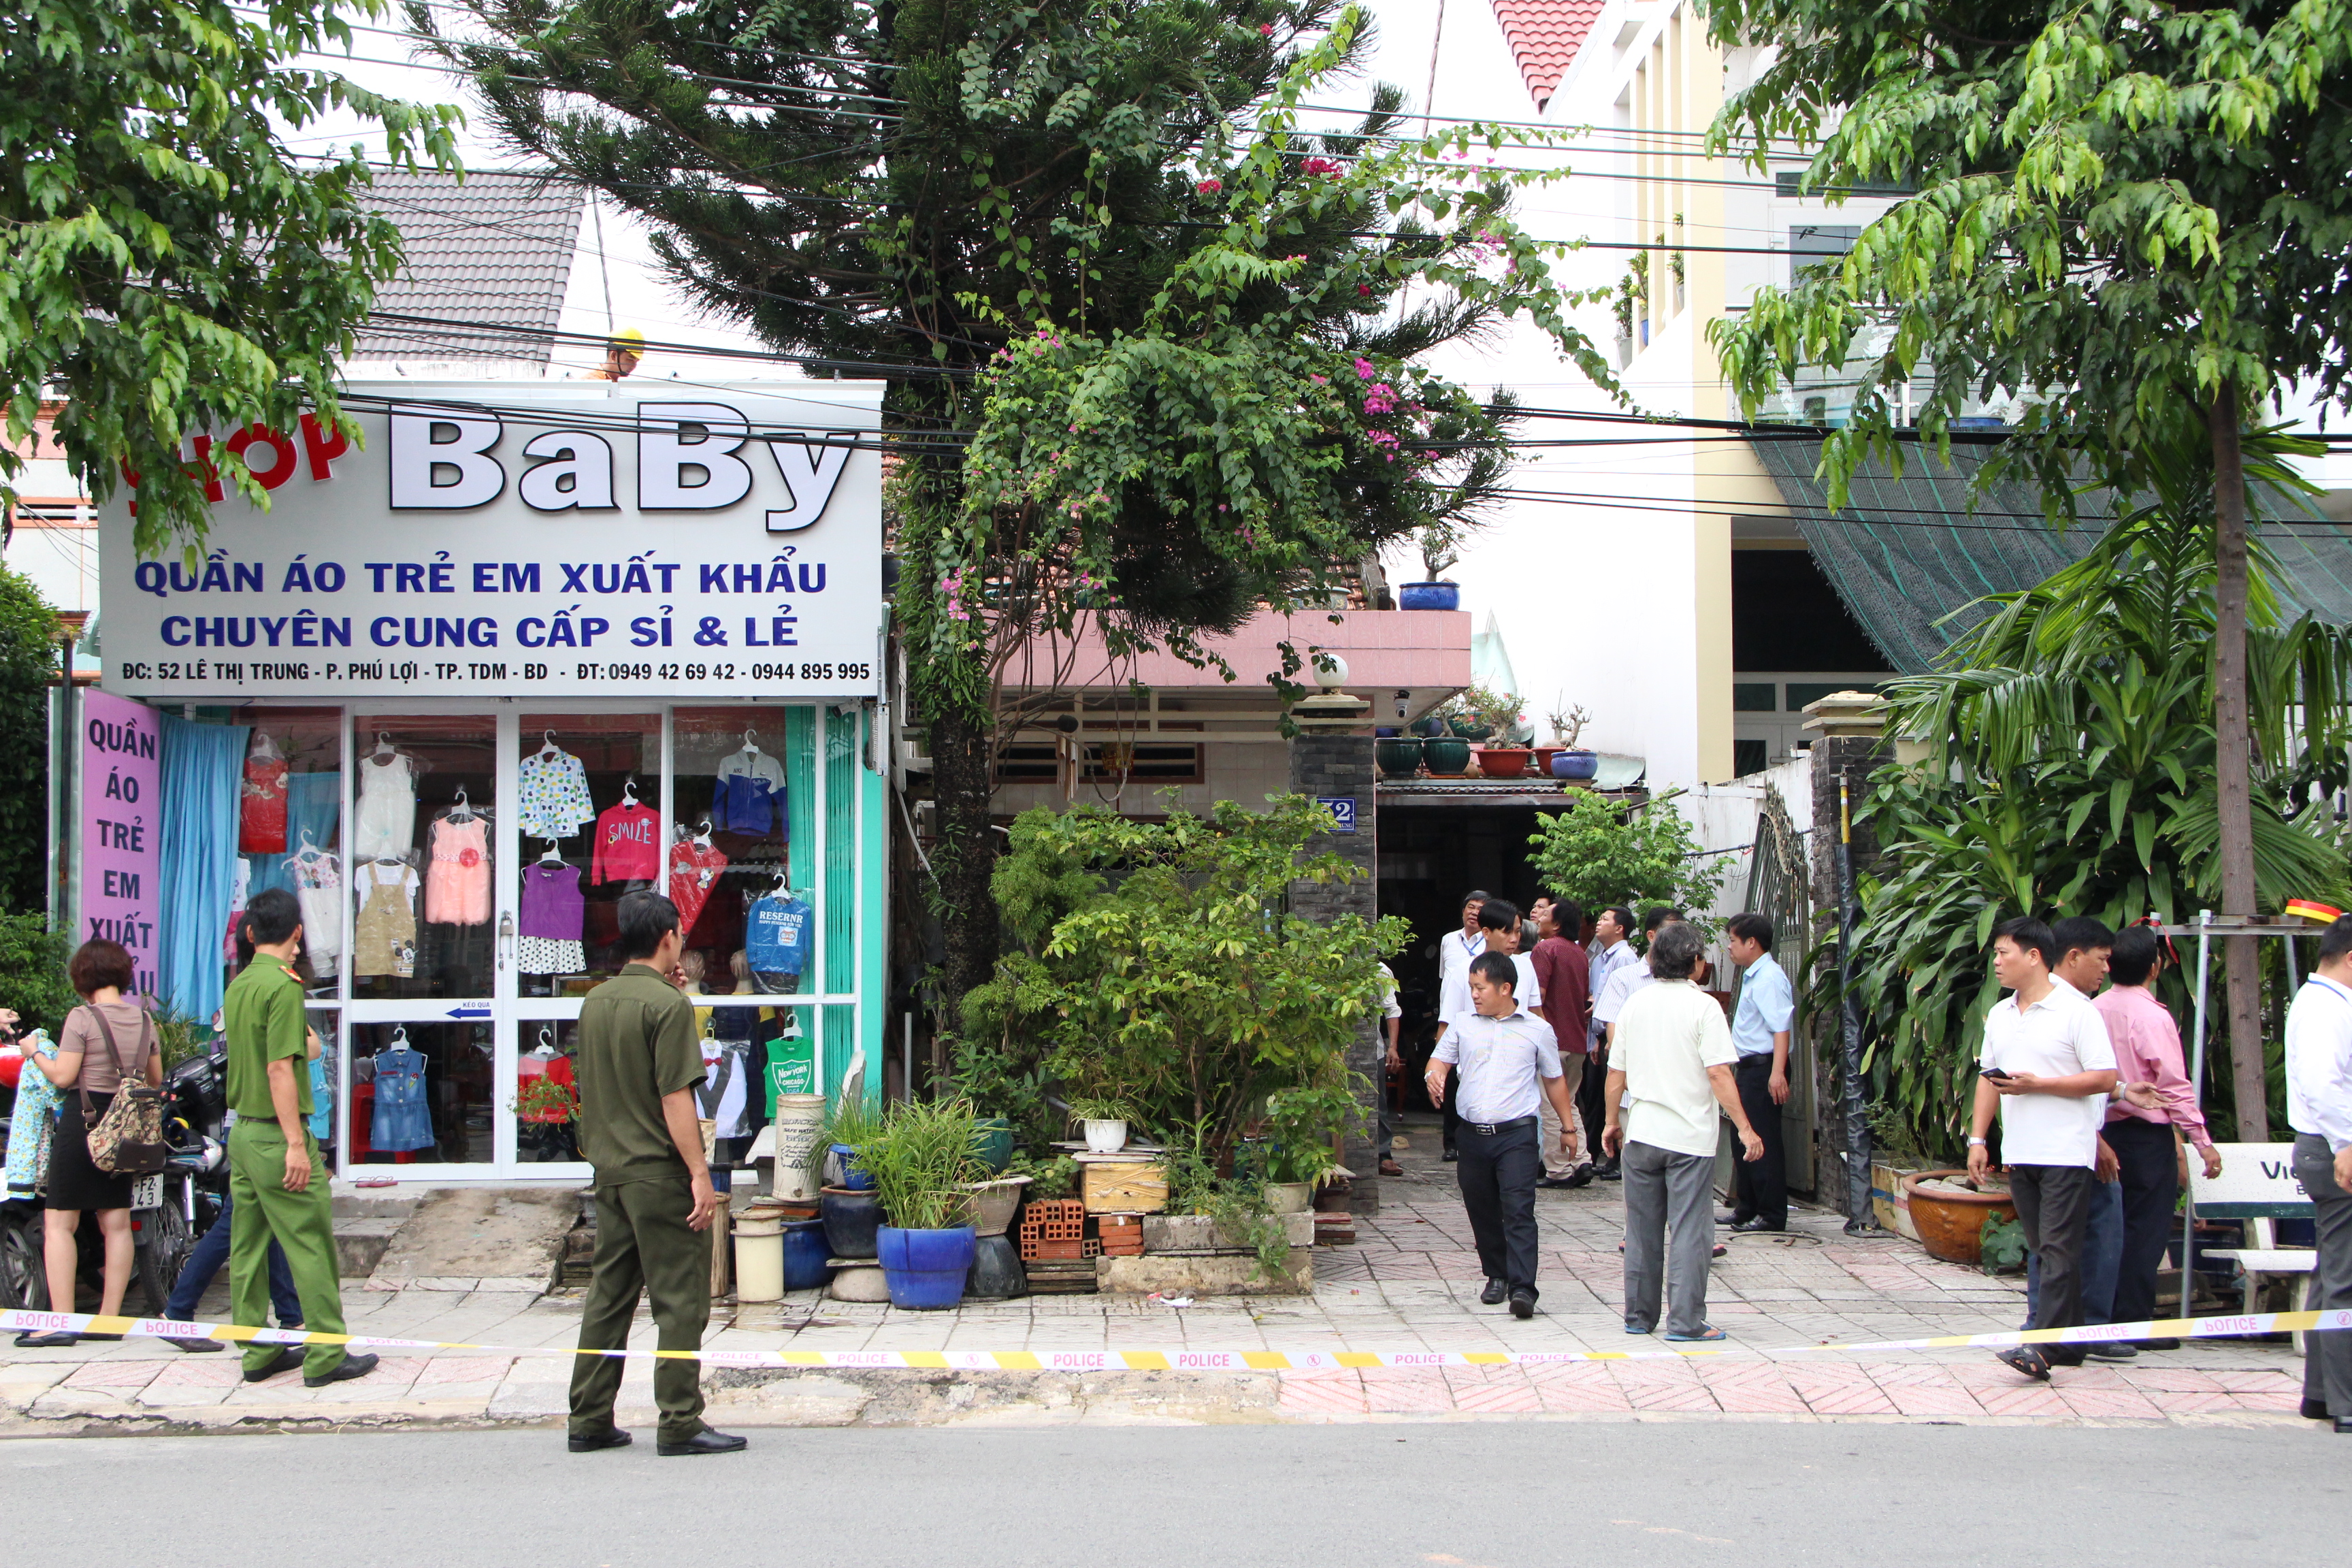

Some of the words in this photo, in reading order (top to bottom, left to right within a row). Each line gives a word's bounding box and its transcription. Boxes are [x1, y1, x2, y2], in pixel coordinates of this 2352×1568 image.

[121, 412, 351, 517] HOP
[389, 402, 860, 533] BaBy
[135, 549, 264, 598] QUẦN
[282, 555, 346, 593] ÁO
[364, 551, 456, 593] TRẺ
[473, 564, 540, 593] EM
[560, 550, 681, 593] XUẤT
[700, 546, 826, 593] KHẨU
[161, 609, 352, 647] CHUYÊN
[370, 617, 498, 648] CUNG
[516, 604, 610, 648] CẤP
[630, 605, 674, 647] SỈ
[693, 616, 728, 647] &
[745, 604, 799, 647] LẺ
[122, 663, 152, 680] ĐC:
[159, 663, 180, 680] 52
[186, 659, 208, 680] LÊ
[214, 663, 243, 685] THỊ
[250, 663, 309, 680] TRUNG
[327, 663, 342, 681] P.
[349, 658, 383, 680] PHÚ
[390, 660, 418, 683] LỢI
[435, 663, 463, 680] TP.
[468, 663, 506, 680] TDM
[525, 663, 548, 680] BD
[577, 663, 605, 680] ĐT:
[608, 663, 652, 680] 0949
[658, 663, 679, 680] 42
[685, 663, 707, 680] 69
[713, 663, 735, 680] 42
[752, 663, 795, 680] 0944
[801, 663, 833, 680] 895
[838, 663, 870, 680] 995
[89, 717, 155, 760] QUẦN
[105, 766, 140, 804] ÁO
[97, 815, 144, 853] TRẺ
[608, 819, 652, 845] SMILE
[103, 870, 140, 900] EM
[89, 912, 153, 949] XUẤT
[838, 1354, 888, 1363] POLICE
[1054, 1354, 1105, 1367] POLICE
[1179, 1354, 1230, 1367] POLICE
[1395, 1354, 1446, 1364] POLICE
